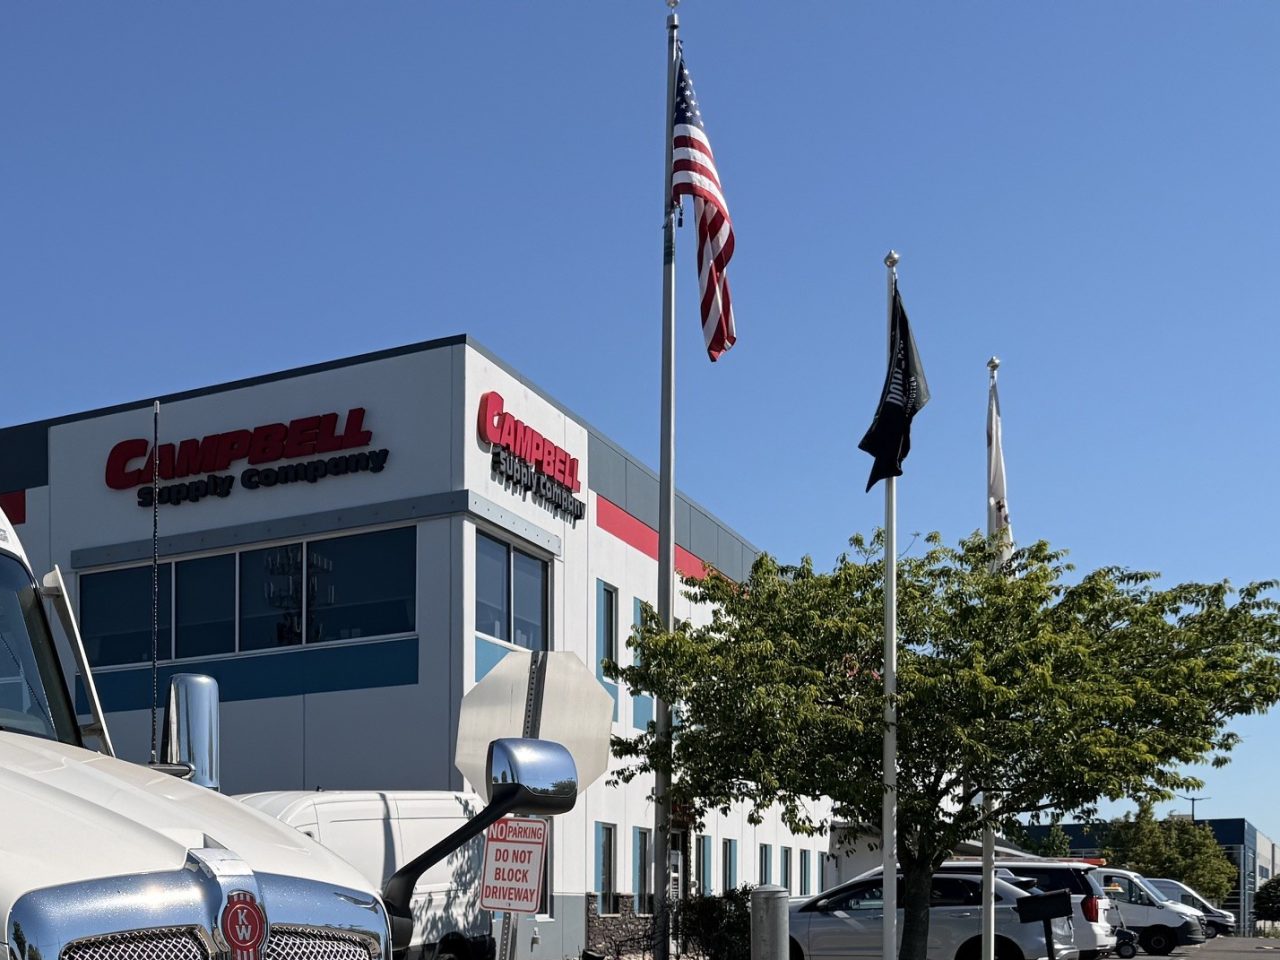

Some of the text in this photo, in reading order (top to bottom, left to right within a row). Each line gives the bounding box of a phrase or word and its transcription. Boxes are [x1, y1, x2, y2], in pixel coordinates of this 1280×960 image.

[105, 407, 372, 489] CAMPBELL
[477, 391, 581, 493] CAMPBELL
[137, 448, 390, 507] Supply Company
[495, 450, 538, 496] Supply
[488, 823, 542, 839] NO PARKING
[495, 848, 533, 864] DO NOT
[494, 867, 529, 883] BLOCK
[484, 885, 536, 903] DRIVEWAY
